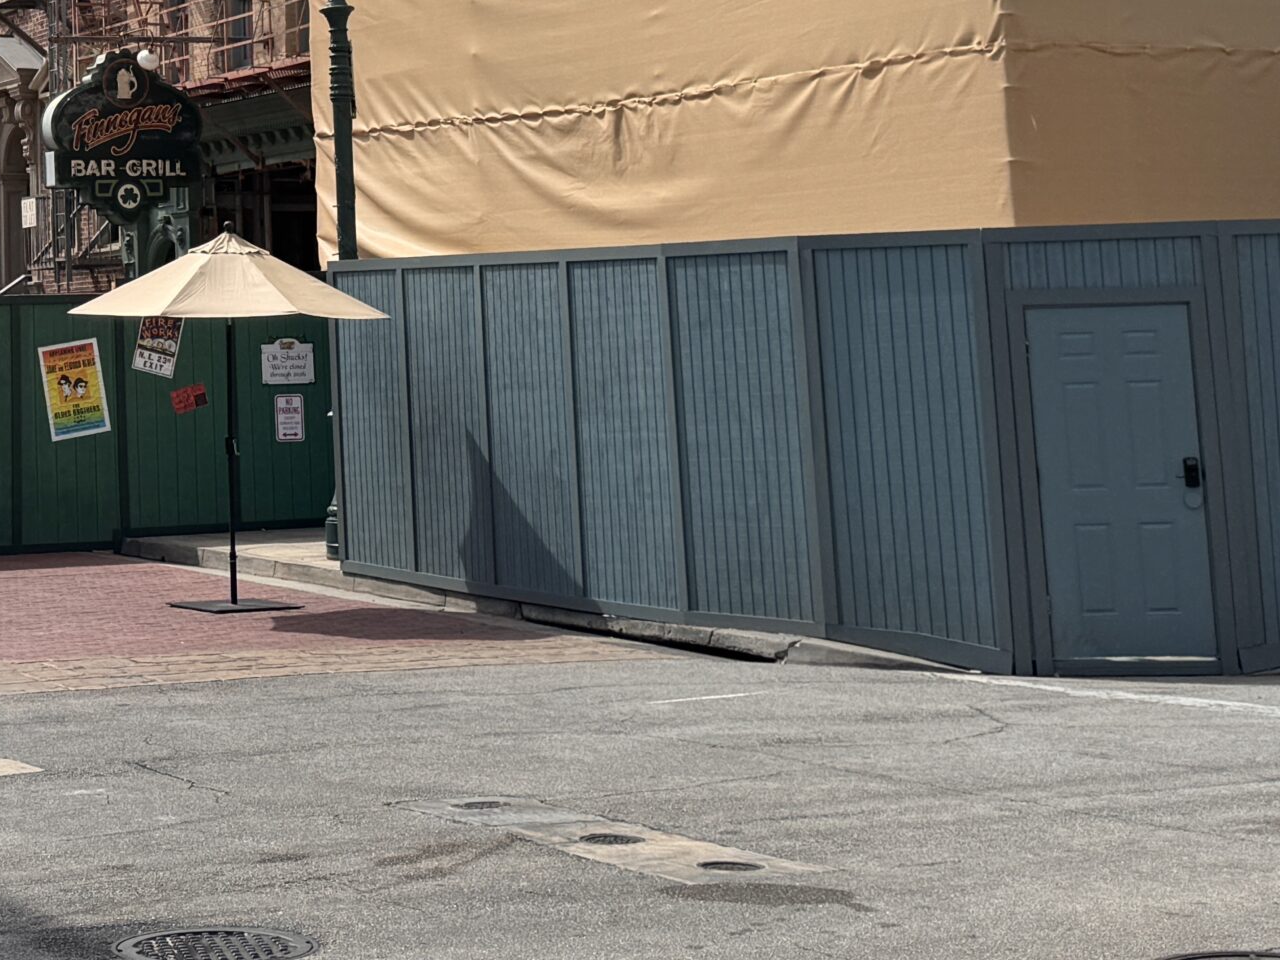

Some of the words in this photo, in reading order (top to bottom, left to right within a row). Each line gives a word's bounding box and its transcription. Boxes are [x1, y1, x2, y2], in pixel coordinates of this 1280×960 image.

[71, 160, 116, 177] BAR
[267, 353, 278, 362] Oh
[280, 353, 307, 363] Shucks!
